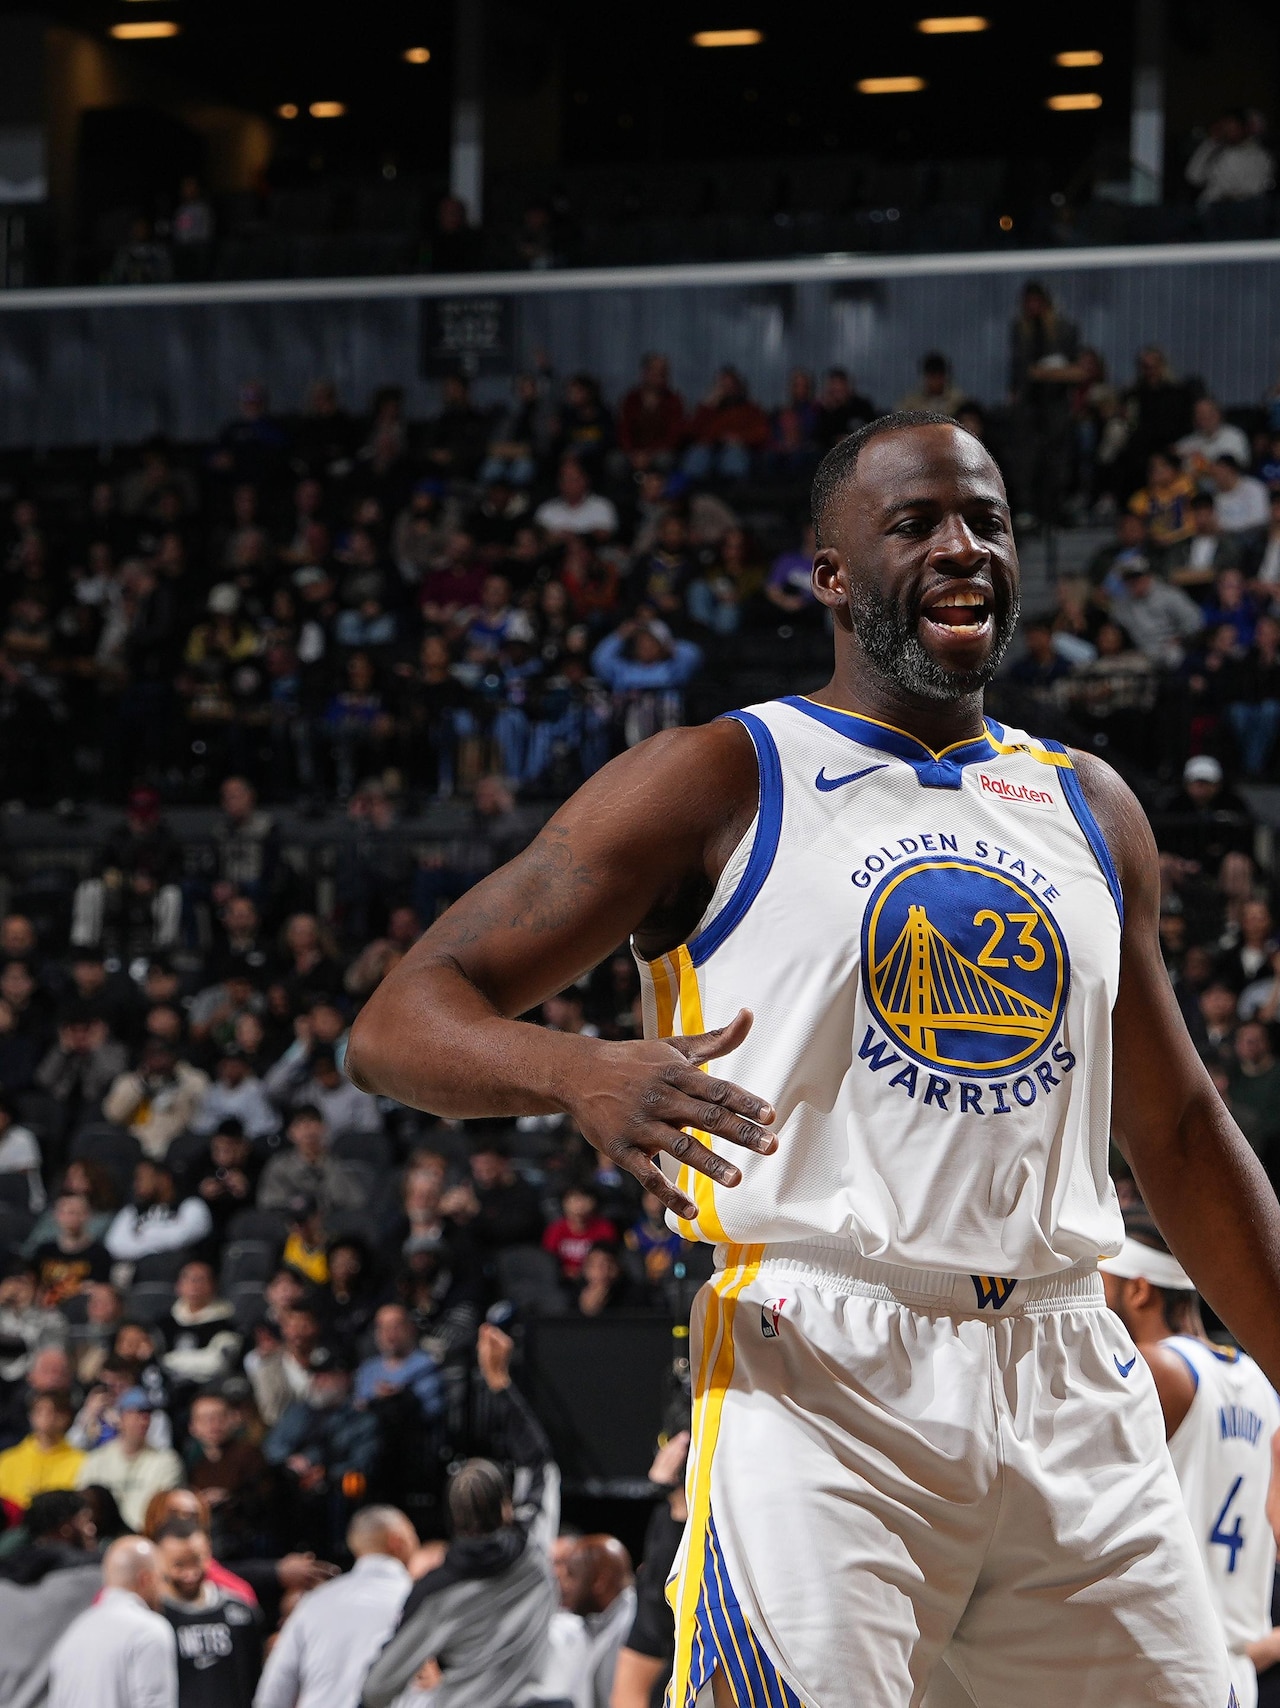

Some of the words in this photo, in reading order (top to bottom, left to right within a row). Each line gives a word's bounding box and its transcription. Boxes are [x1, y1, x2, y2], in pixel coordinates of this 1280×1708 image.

[979, 774, 1054, 805] Rakuten
[851, 833, 958, 889] GOLDEN
[976, 840, 1060, 904] STATE
[973, 909, 1046, 972] 23
[857, 1024, 1077, 1116] WARRIORS
[1209, 1475, 1244, 1574] 4
